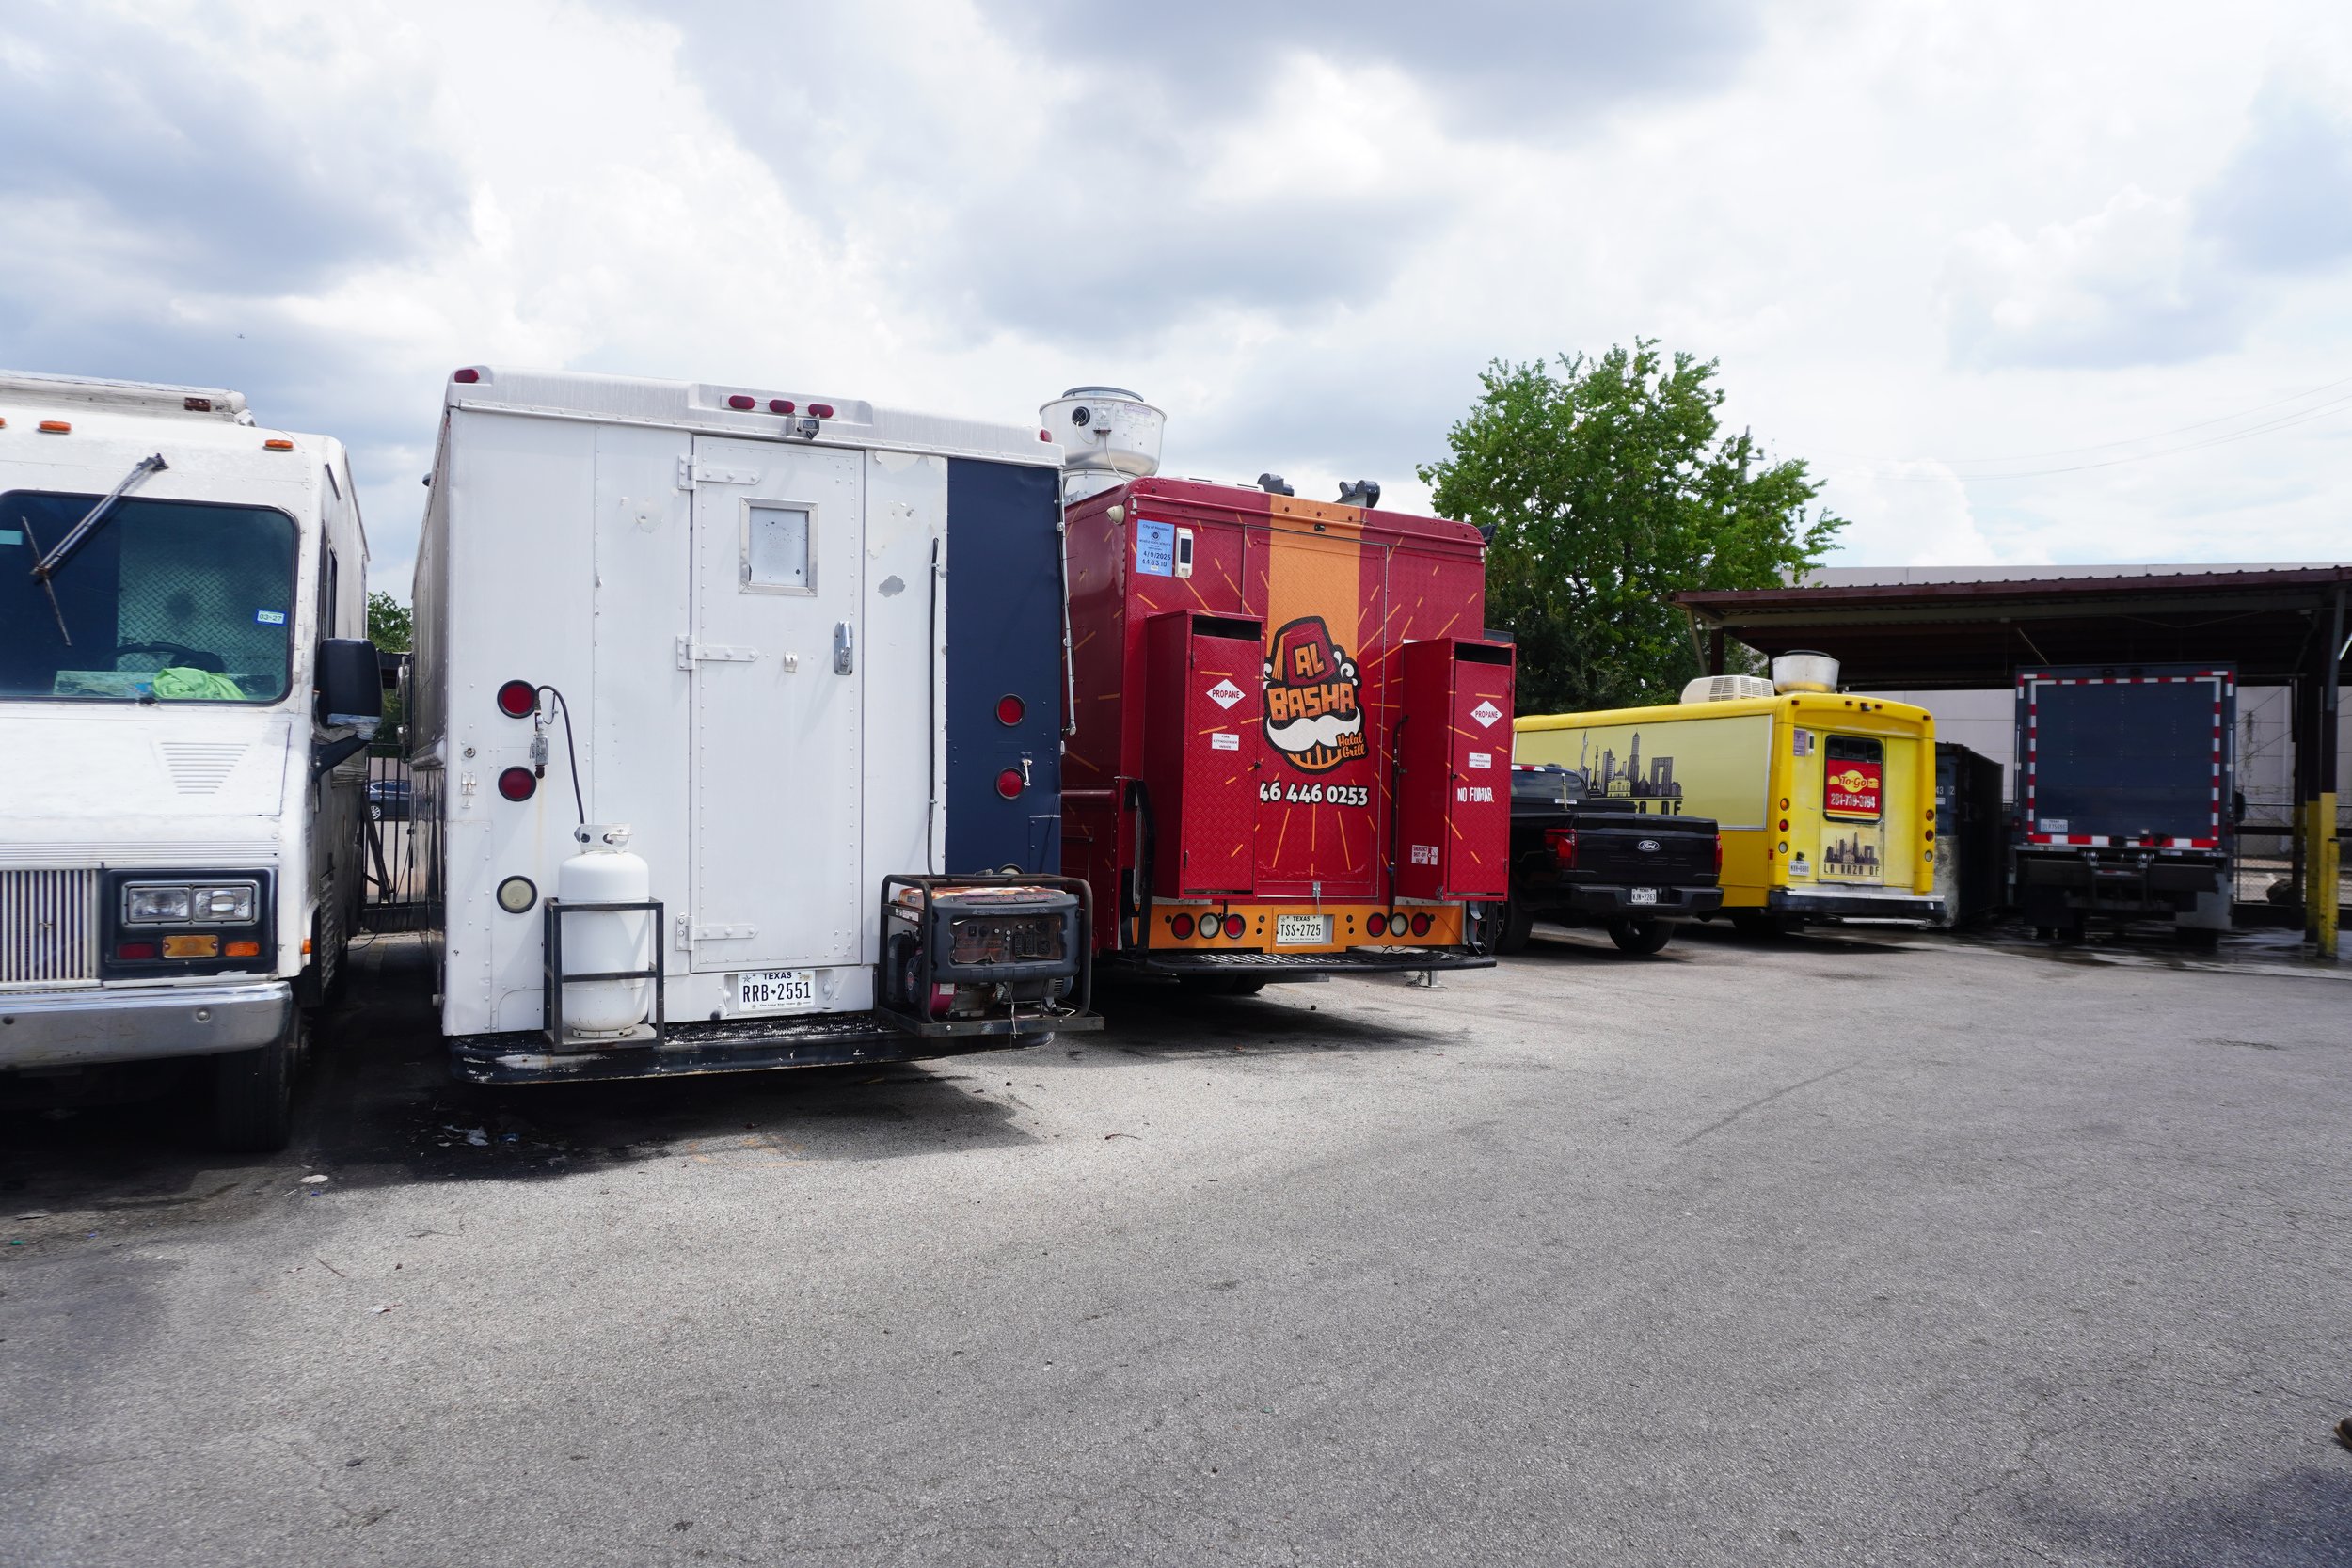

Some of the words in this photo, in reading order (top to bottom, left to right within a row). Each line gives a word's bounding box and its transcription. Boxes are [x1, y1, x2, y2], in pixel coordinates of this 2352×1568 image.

[1295, 643, 1325, 677] AL
[1212, 689, 1240, 699] PROPANE
[1266, 683, 1356, 721] BASHA
[1475, 710, 1498, 719] PROPANE
[1336, 733, 1364, 747] Halal
[1342, 745, 1366, 758] Grill
[1841, 776, 1867, 788] To-Go
[1286, 784, 1323, 803] 446
[1327, 784, 1369, 806] 0253
[1457, 787, 1468, 802] NO
[1470, 787, 1493, 802] FUMAR
[763, 971, 792, 980] TEXAS
